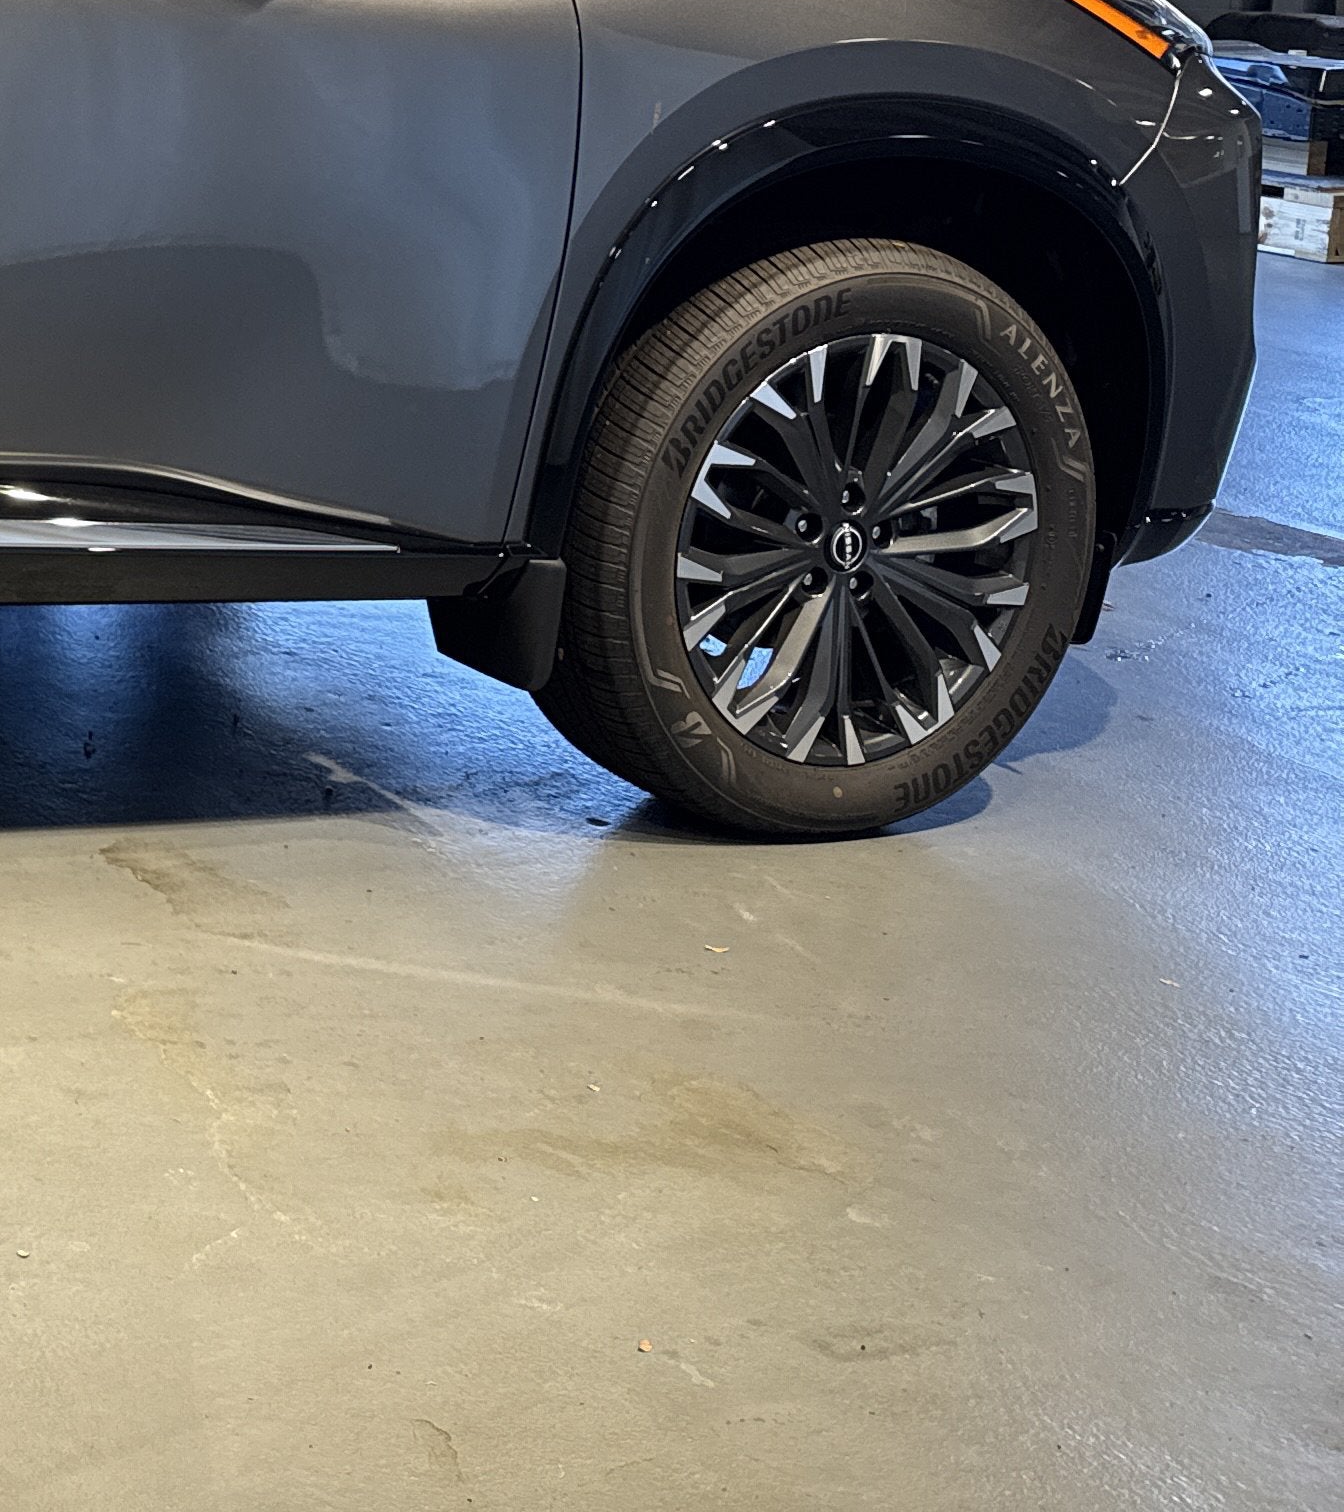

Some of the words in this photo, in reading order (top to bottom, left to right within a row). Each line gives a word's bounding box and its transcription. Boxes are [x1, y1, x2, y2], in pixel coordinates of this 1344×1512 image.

[661, 288, 853, 478] BRIDGESTONE
[1000, 324, 1082, 449] ALENZA
[893, 623, 1070, 813] BRIDGESTONE
